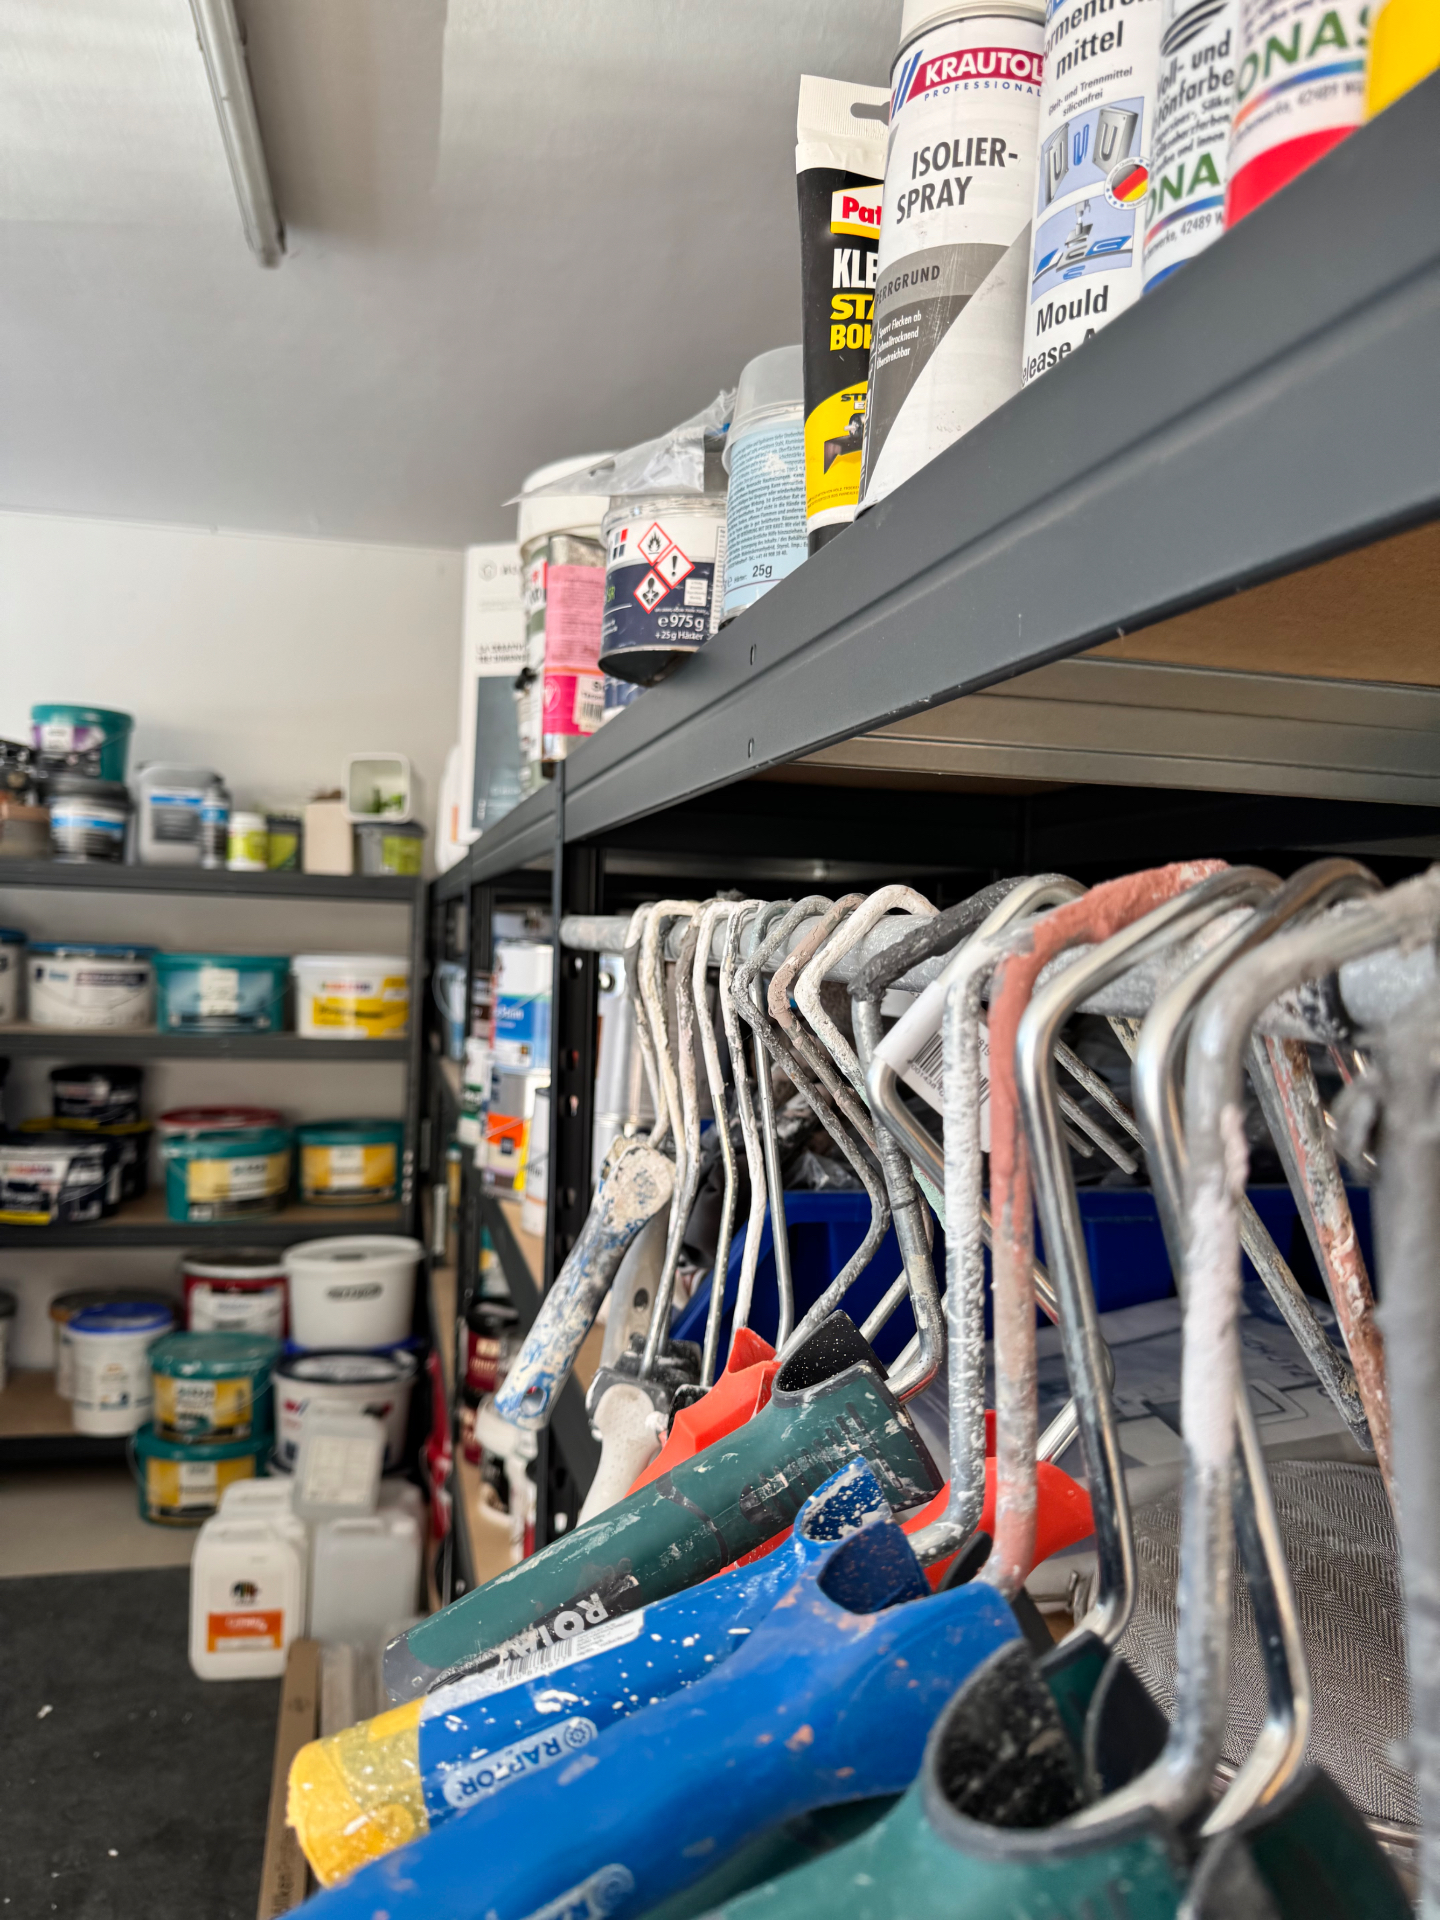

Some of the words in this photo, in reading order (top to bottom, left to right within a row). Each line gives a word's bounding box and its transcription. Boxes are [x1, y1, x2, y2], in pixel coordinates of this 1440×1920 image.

[1056, 20, 1123, 80] mittel
[1191, 28, 1231, 70] und
[924, 51, 1042, 86] KRAUTOL
[1064, 86, 1078, 100] und
[1080, 66, 1133, 92] Trennmittel
[924, 81, 1042, 101] PROFESSIONAL
[1063, 88, 1103, 117] siliconfrei
[911, 137, 1018, 180] ISOLIER-
[896, 176, 973, 224] SPRAY
[913, 310, 921, 321] ab
[1036, 285, 1108, 336] Mould
[752, 564, 773, 578] 25g
[461, 1736, 564, 1799] RAPTOR
